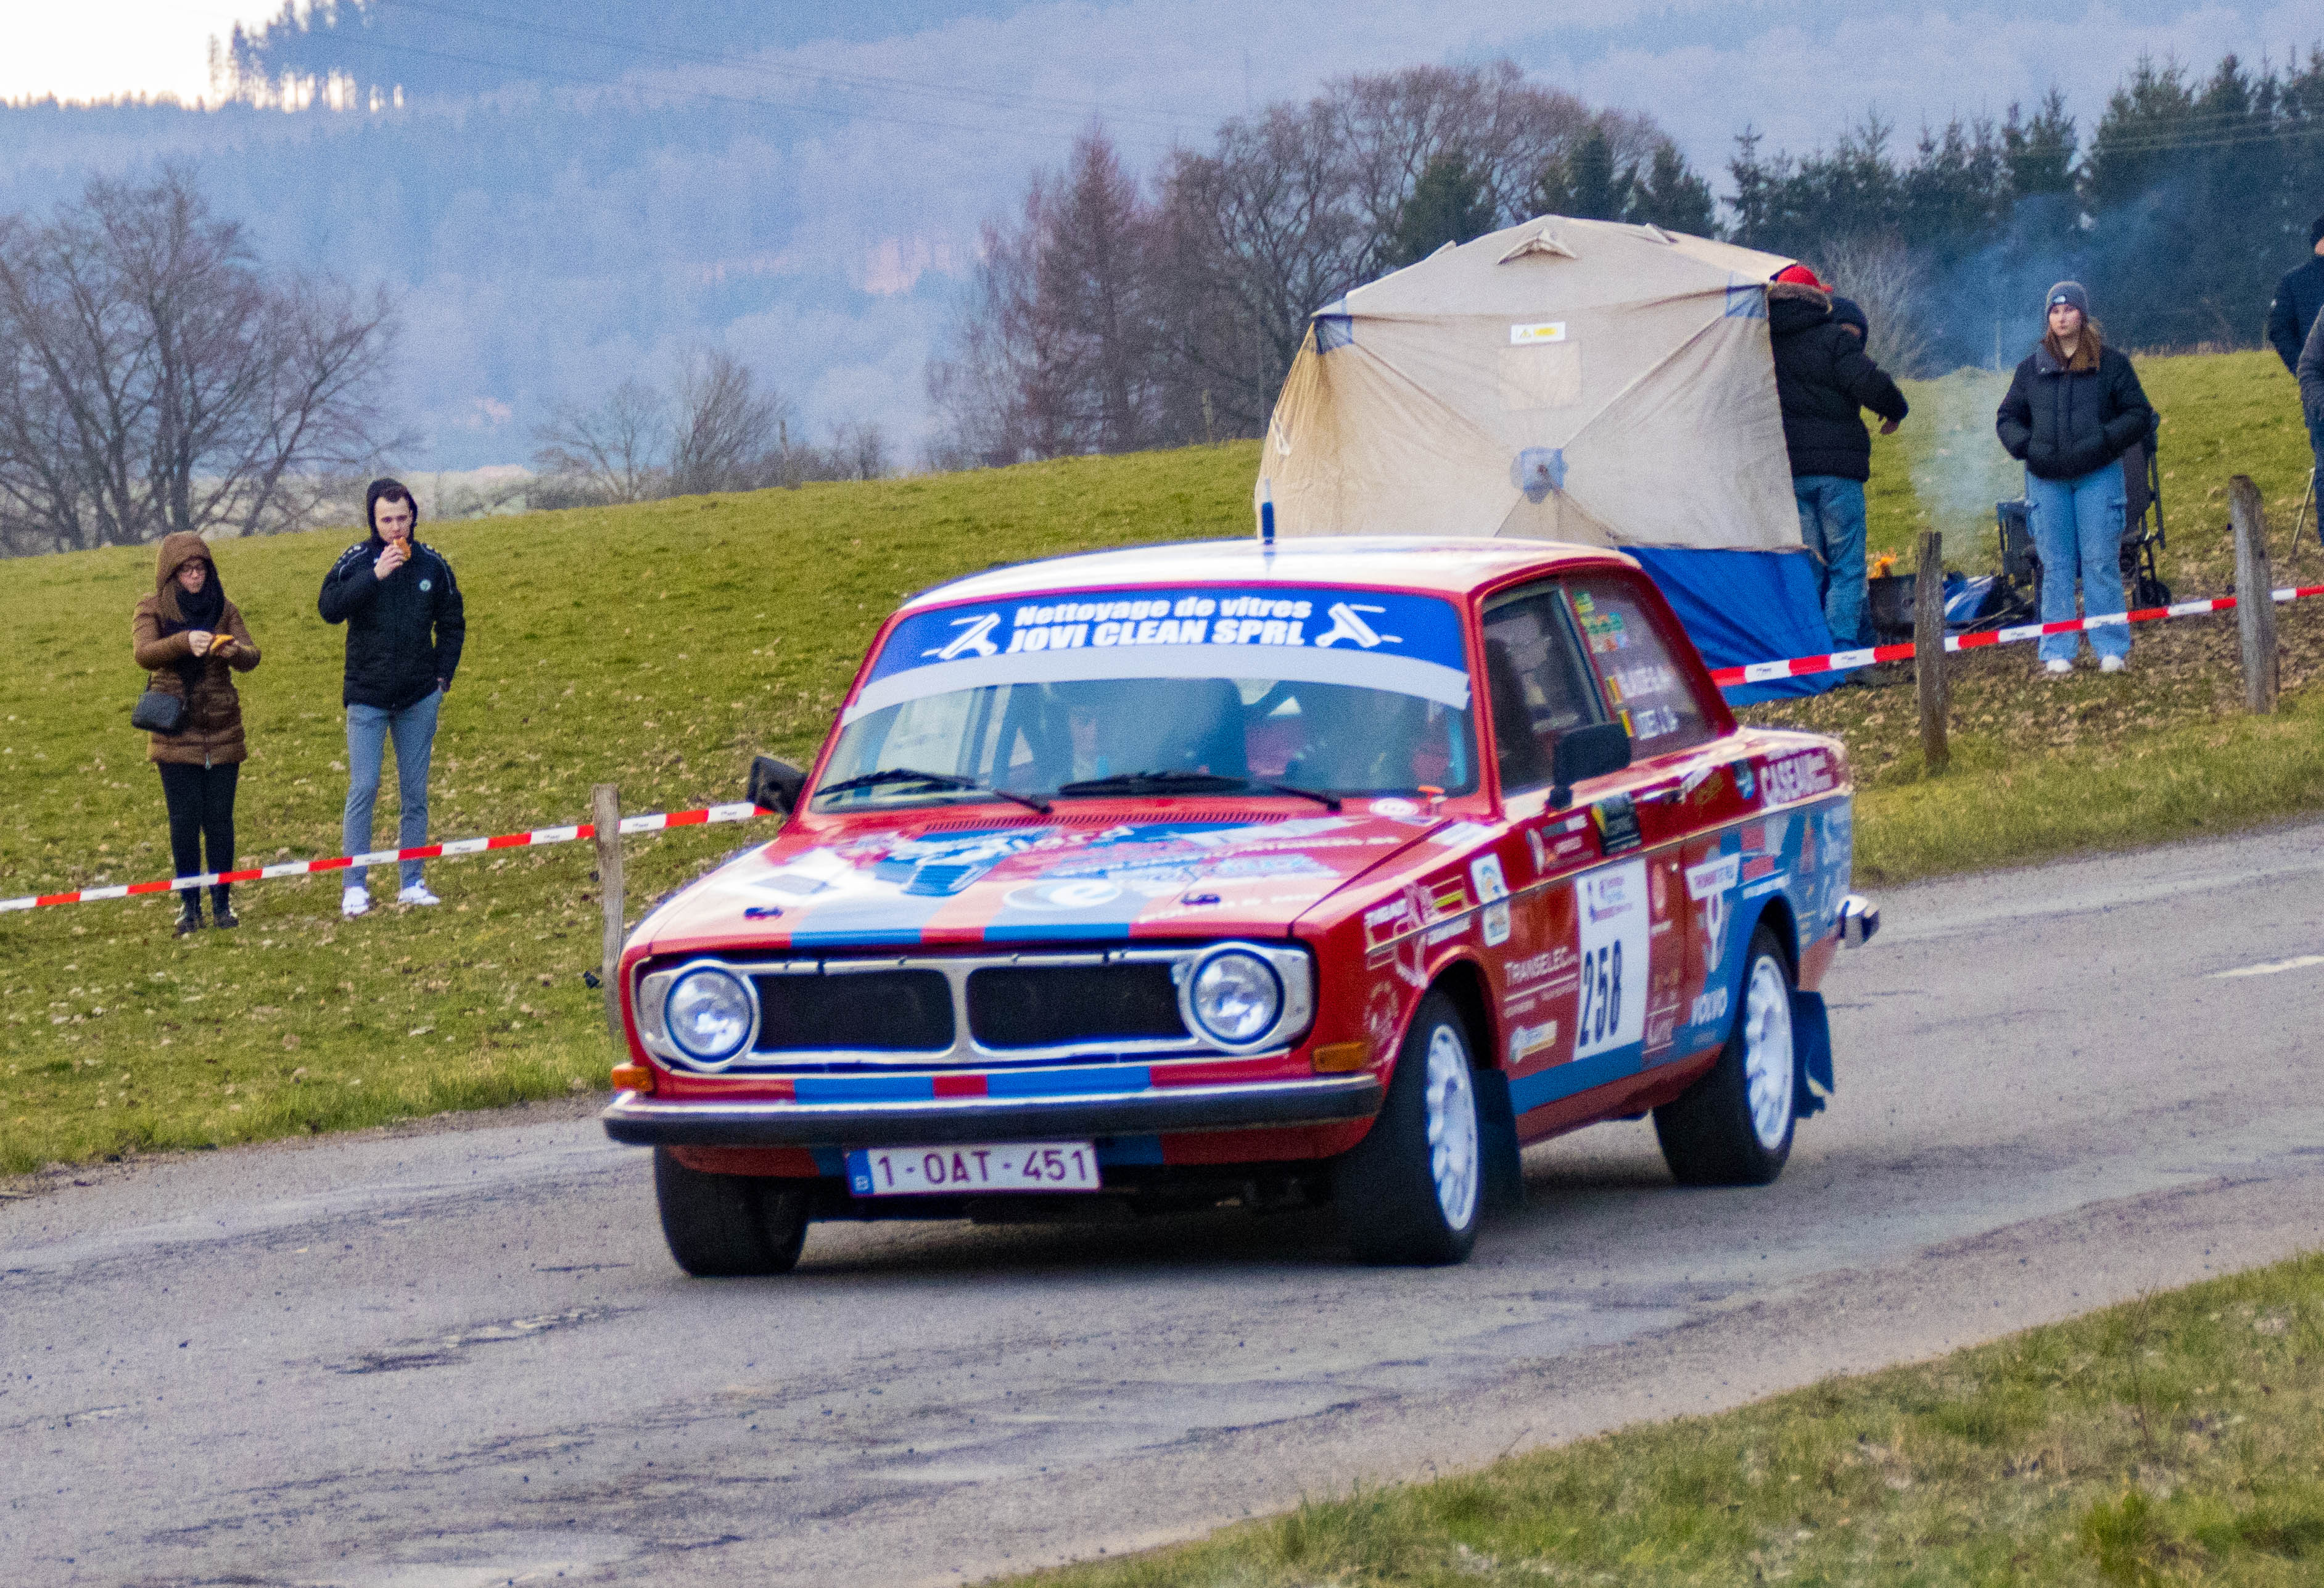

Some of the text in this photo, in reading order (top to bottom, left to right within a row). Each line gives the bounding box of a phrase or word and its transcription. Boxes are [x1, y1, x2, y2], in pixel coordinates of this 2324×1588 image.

[1014, 597, 1312, 627] Nettoyage de vitres
[1006, 619, 1304, 653] JOVI CLEAN SPRL
